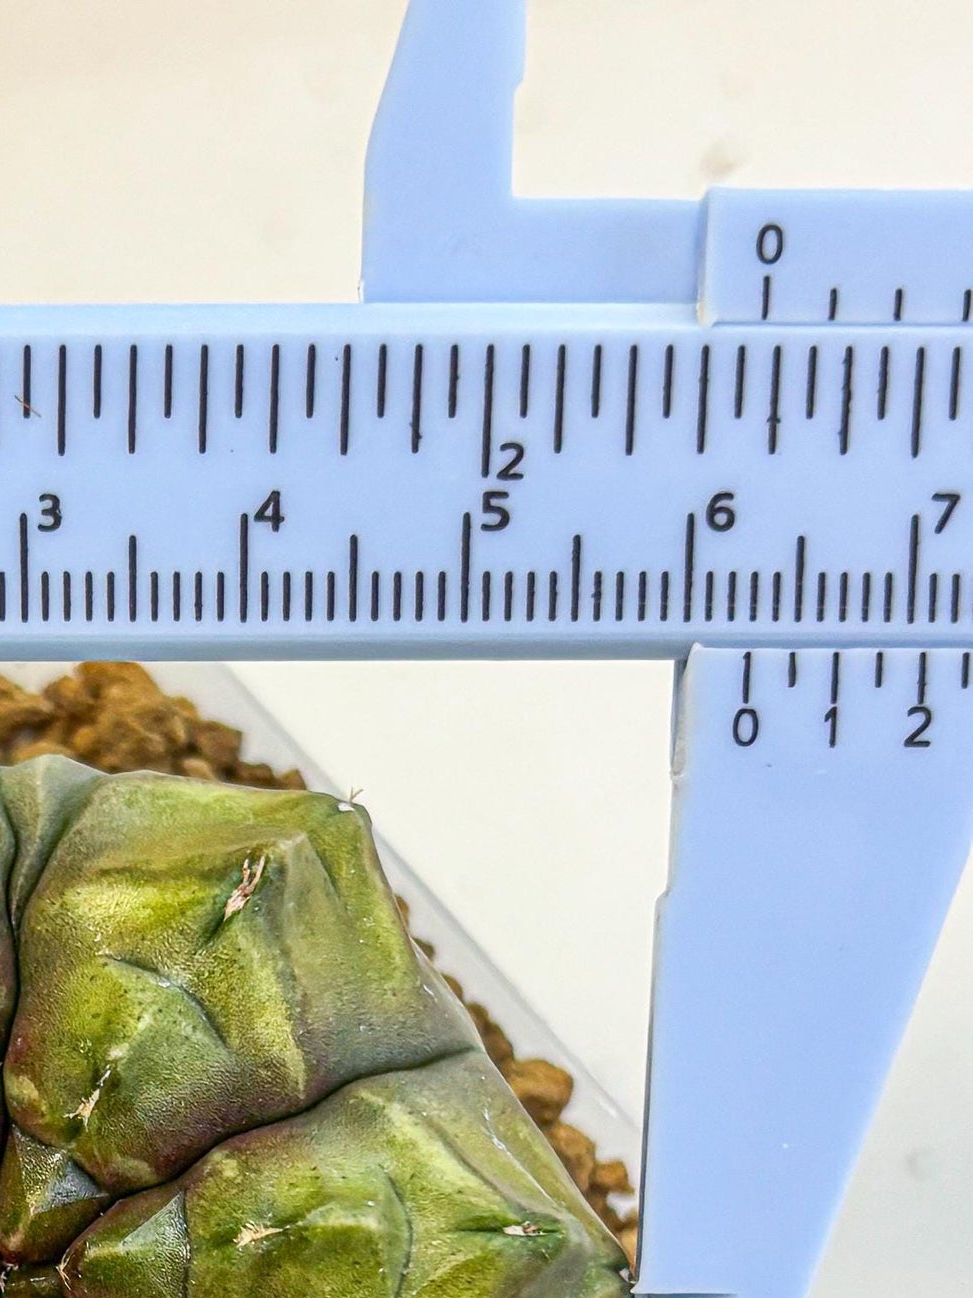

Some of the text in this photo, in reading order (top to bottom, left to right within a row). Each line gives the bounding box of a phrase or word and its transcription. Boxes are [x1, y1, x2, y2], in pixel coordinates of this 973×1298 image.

[755, 223, 784, 265] 0
[496, 441, 525, 482] 2
[37, 493, 63, 533] 3
[253, 489, 286, 533] 4
[480, 490, 511, 532] 5
[705, 491, 736, 533] 6
[931, 492, 961, 535] 7
[732, 705, 933, 749] 0 1 2
